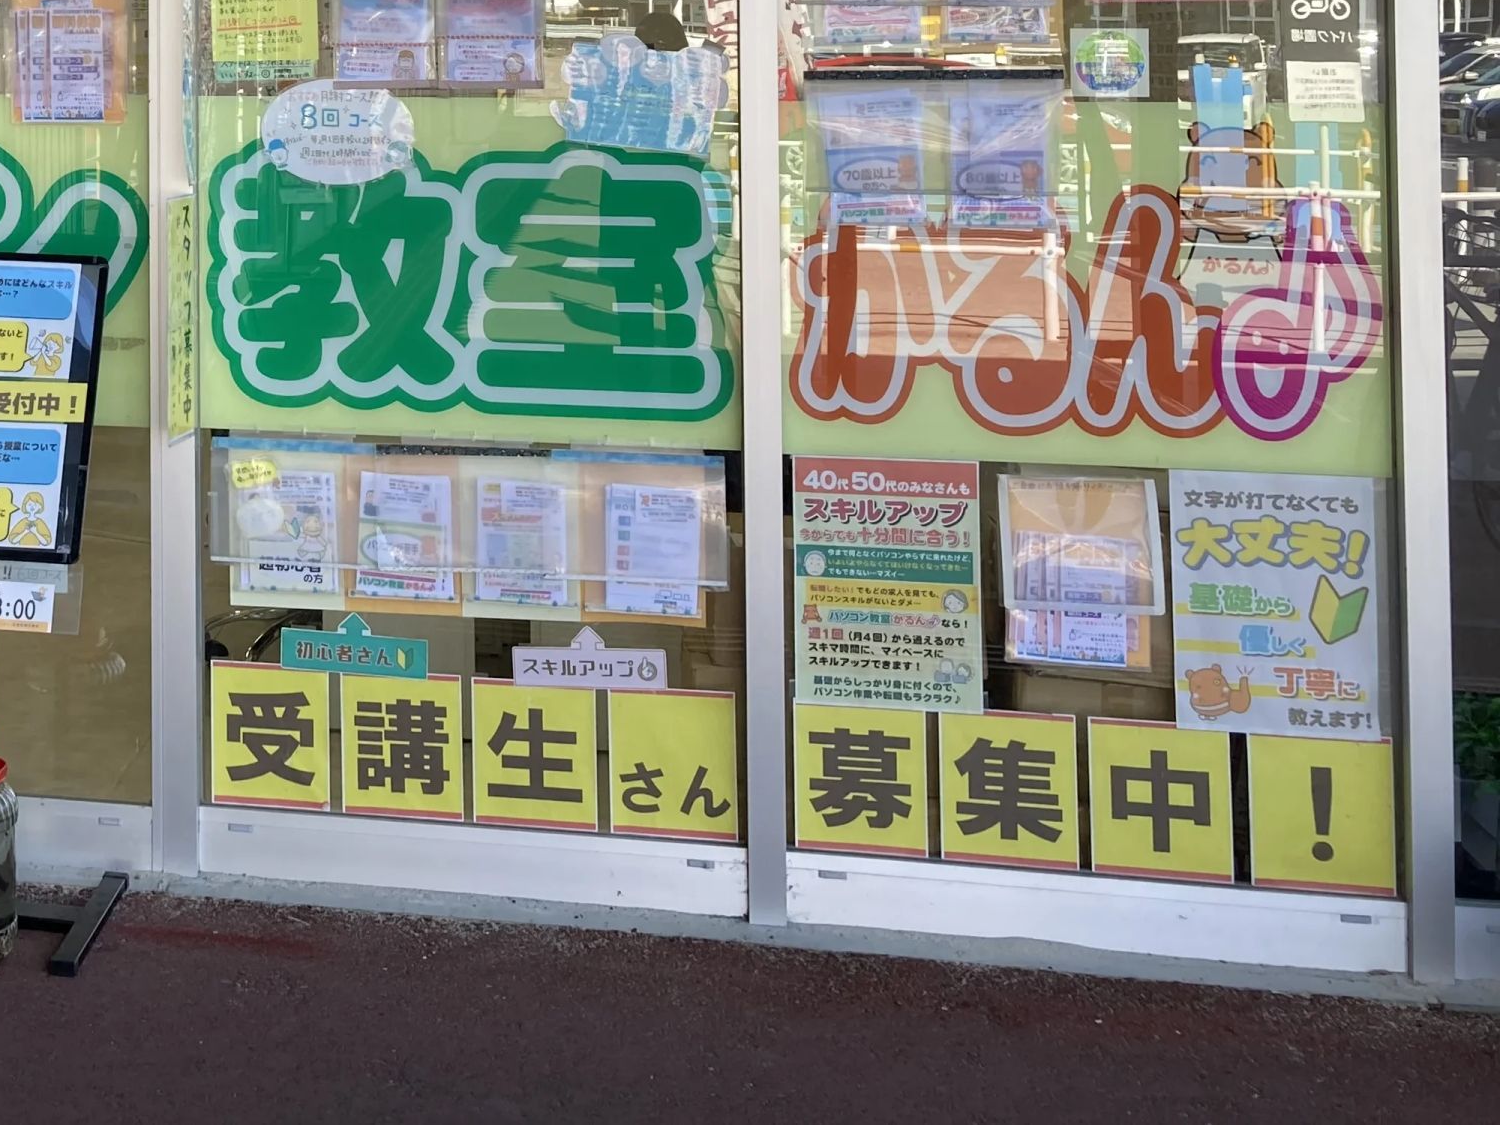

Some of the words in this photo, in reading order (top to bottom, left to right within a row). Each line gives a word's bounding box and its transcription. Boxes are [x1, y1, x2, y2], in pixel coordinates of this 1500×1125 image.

[205, 139, 736, 423] 教室
[803, 498, 968, 527] スキルアップ
[1184, 490, 1359, 514] 文字が打てなくても
[800, 527, 970, 548] 今からでも十分間に合う!
[1176, 515, 1370, 580] 大丈夫!
[303, 574, 324, 584] の方
[1188, 581, 1295, 617] 基礎から
[828, 610, 891, 624] パソコン教室
[296, 640, 393, 668] 初心者さん
[808, 656, 920, 671] スキルアップできます!
[522, 657, 635, 679] スキルアップ
[1273, 666, 1361, 699] 丁寧に
[1288, 707, 1373, 729] 教えます!
[225, 691, 732, 819] 受講生さん
